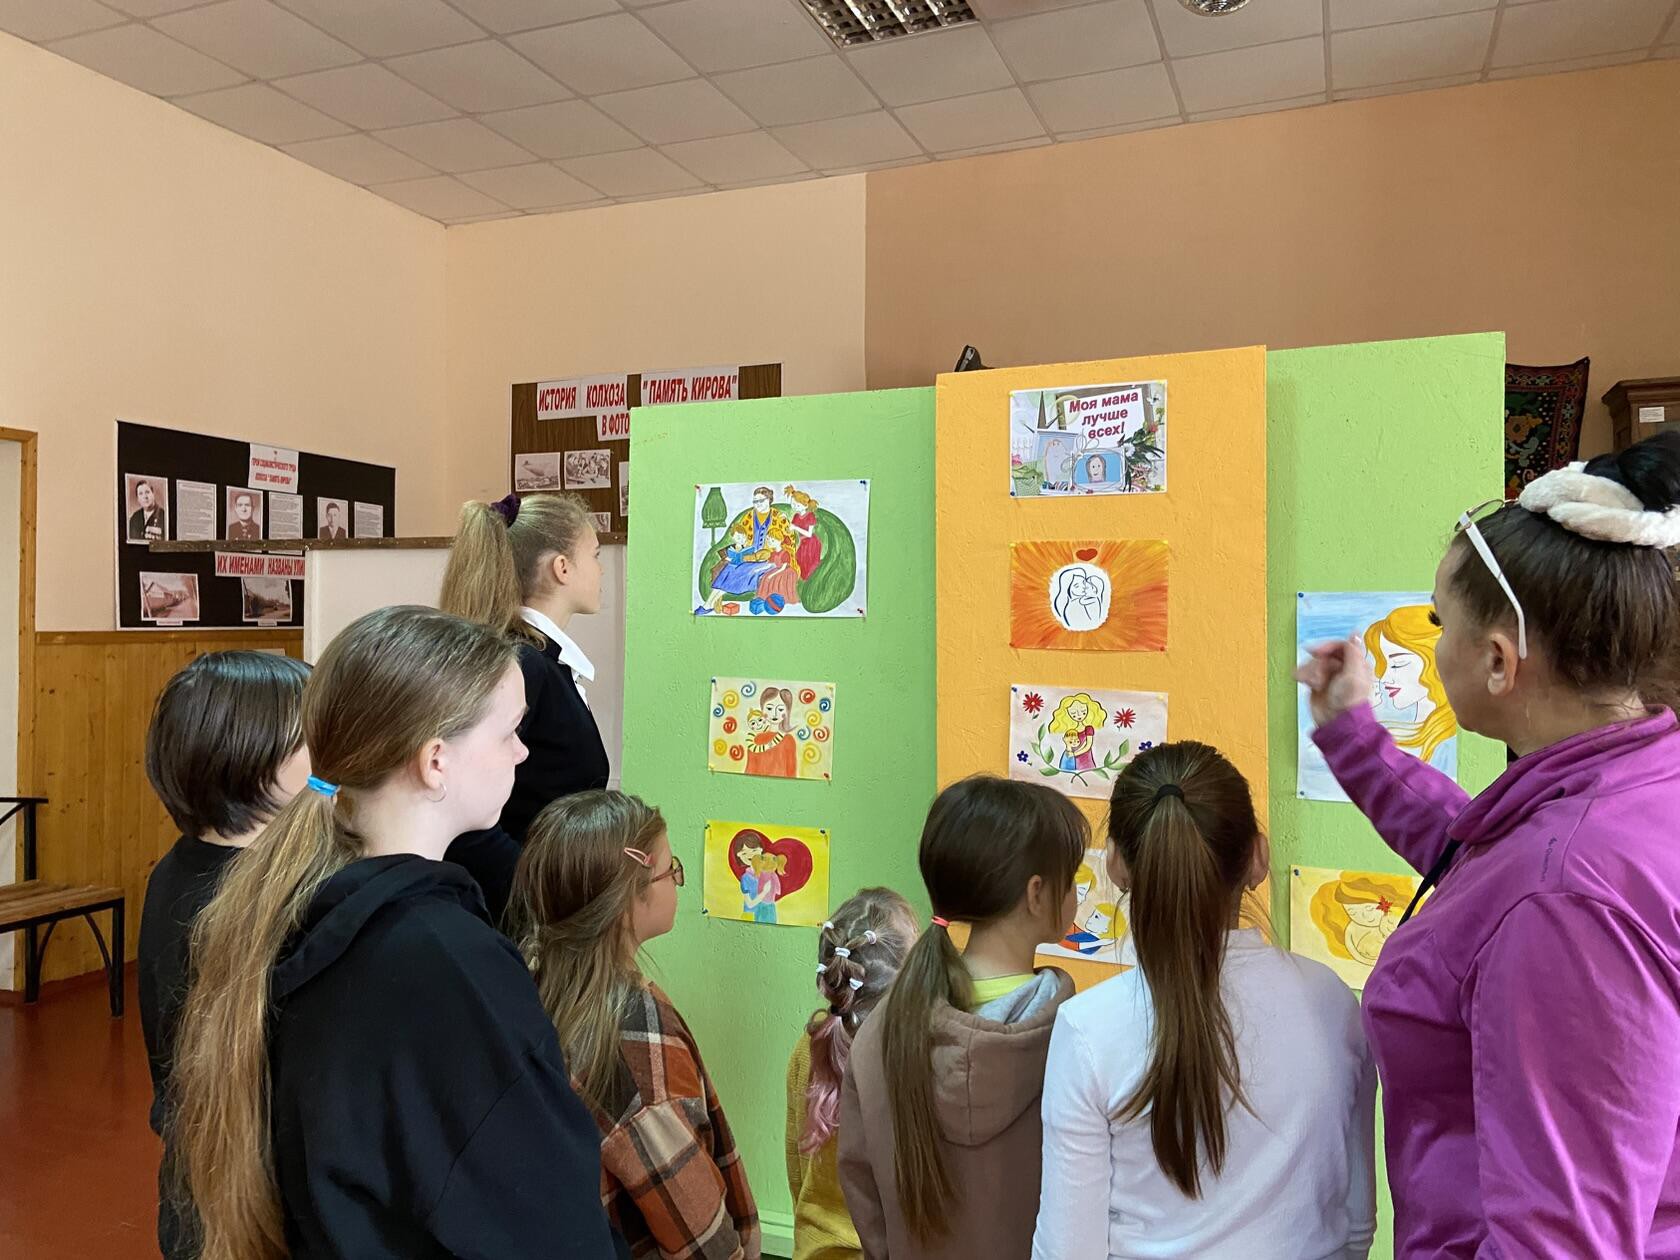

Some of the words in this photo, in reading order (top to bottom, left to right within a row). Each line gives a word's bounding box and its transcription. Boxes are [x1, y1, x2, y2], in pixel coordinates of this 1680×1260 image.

[539, 386, 577, 412] ИСТОРИЯ
[586, 383, 625, 409] КОЛХОЗА
[643, 378, 688, 404] "ПАМЯТЬ
[691, 375, 737, 401] КИРОВА"
[1069, 400, 1098, 413] Моя
[1101, 392, 1139, 408] мама
[602, 414, 607, 436] В
[1081, 409, 1128, 427] лучше
[1088, 421, 1125, 439] всех!
[217, 555, 228, 574] ИХ
[229, 556, 265, 575] ИМЕНАМИ
[268, 557, 293, 576] НАЗВАНЫ
